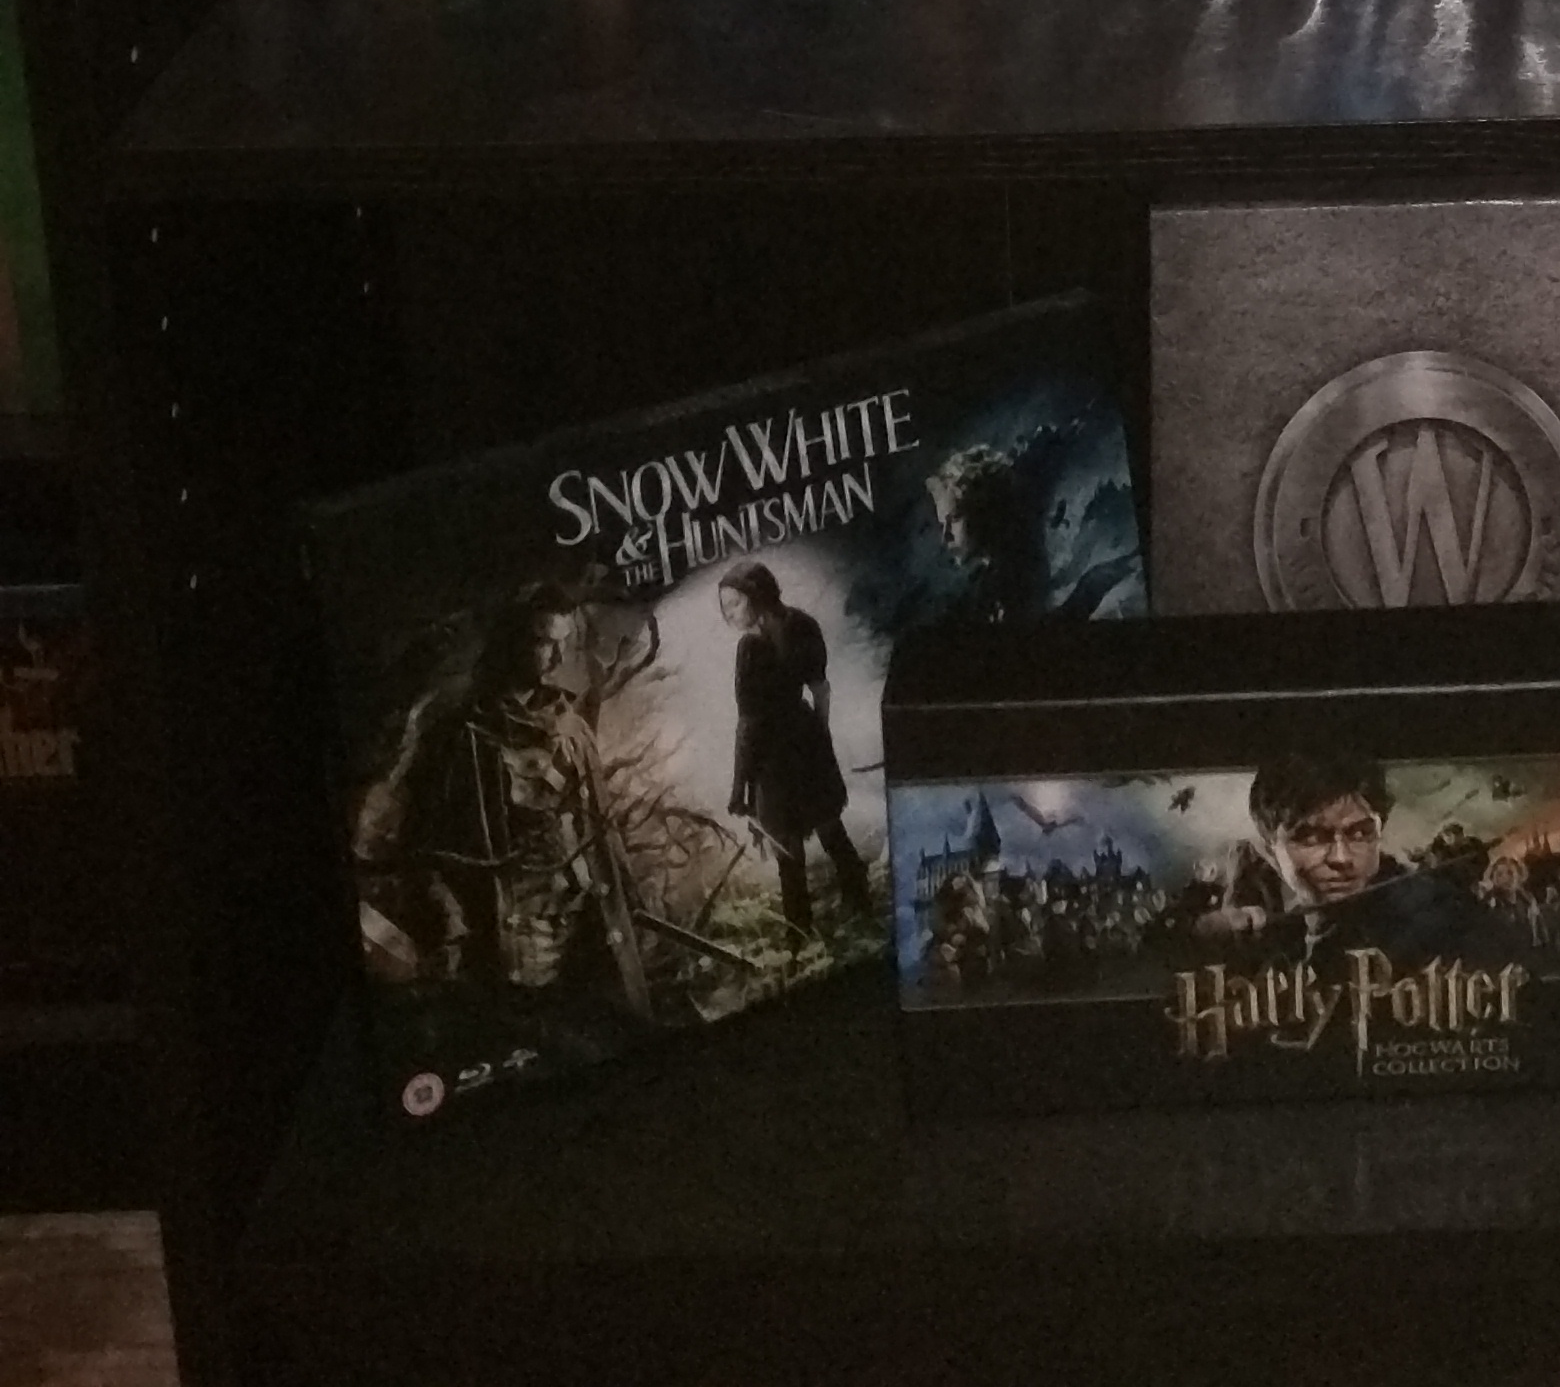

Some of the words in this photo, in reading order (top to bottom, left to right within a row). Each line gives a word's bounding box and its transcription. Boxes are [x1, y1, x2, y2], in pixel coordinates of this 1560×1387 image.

[547, 441, 728, 547] SNOW
[726, 389, 921, 491] WHITE
[614, 525, 655, 567] &
[622, 561, 660, 588] THE
[655, 462, 875, 586] HUNTSMAN
[1164, 961, 1343, 1063] Harry
[1344, 946, 1530, 1078] Potter
[1375, 1037, 1511, 1057] HOGWARTS
[1371, 1056, 1523, 1077] COLLECTION
